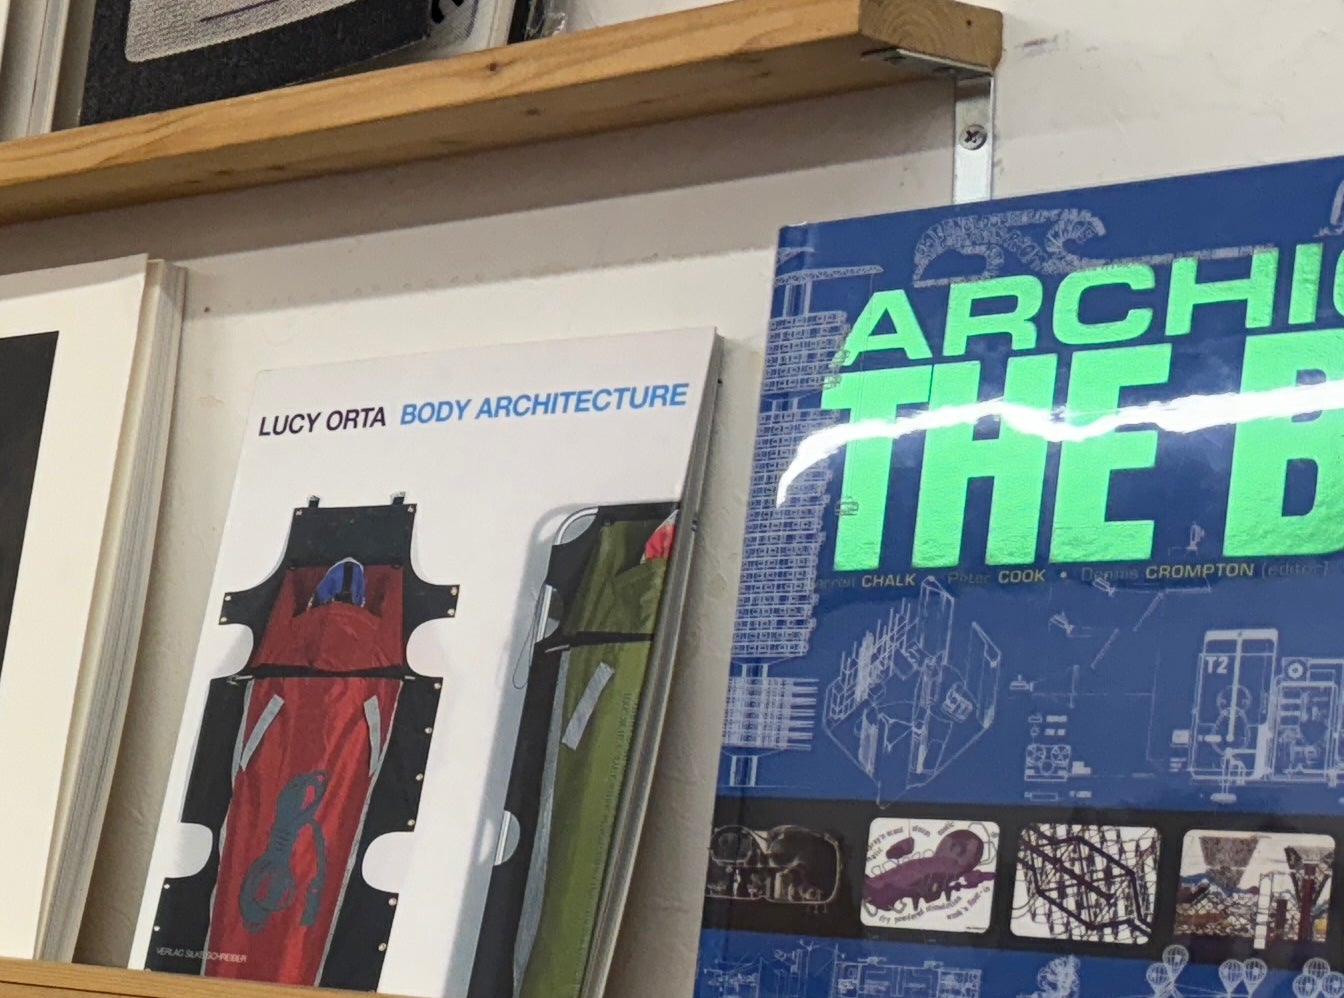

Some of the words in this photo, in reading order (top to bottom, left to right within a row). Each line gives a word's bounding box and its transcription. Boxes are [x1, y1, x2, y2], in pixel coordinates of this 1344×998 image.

[833, 242, 1344, 366] ARCHI
[258, 412, 321, 436] LUCY
[325, 406, 387, 431] ORTA
[400, 399, 472, 425] BODY
[475, 383, 690, 420] ARCHITECTURE
[821, 343, 1172, 572] THE
[861, 573, 916, 589] CHALK
[998, 569, 1046, 584] COOK
[1145, 563, 1255, 580] CROMPTON
[1205, 656, 1228, 674] T2
